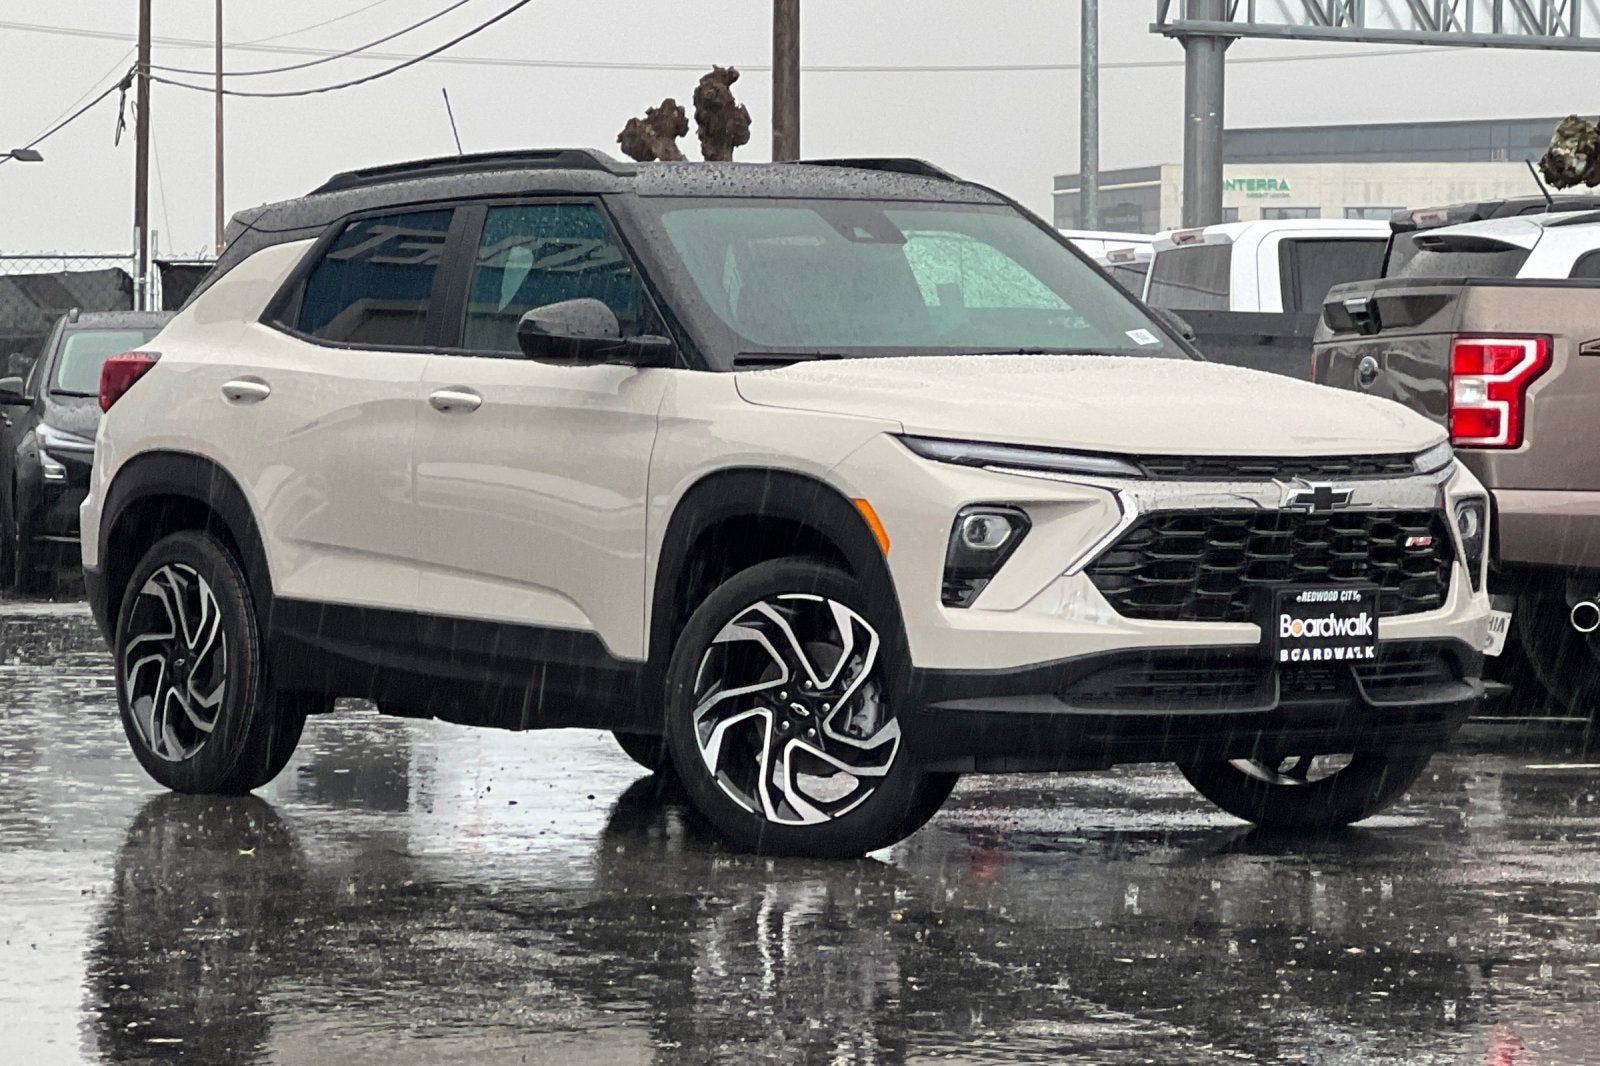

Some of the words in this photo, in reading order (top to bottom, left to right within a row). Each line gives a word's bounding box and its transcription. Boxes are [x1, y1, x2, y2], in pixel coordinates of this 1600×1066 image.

[1223, 178, 1290, 191] NTERRA
[1302, 590, 1338, 602] REDWOOD
[1340, 590, 1359, 601] CITY
[1280, 612, 1373, 637] Boardwalk
[1280, 646, 1375, 662] BOARDWALK
